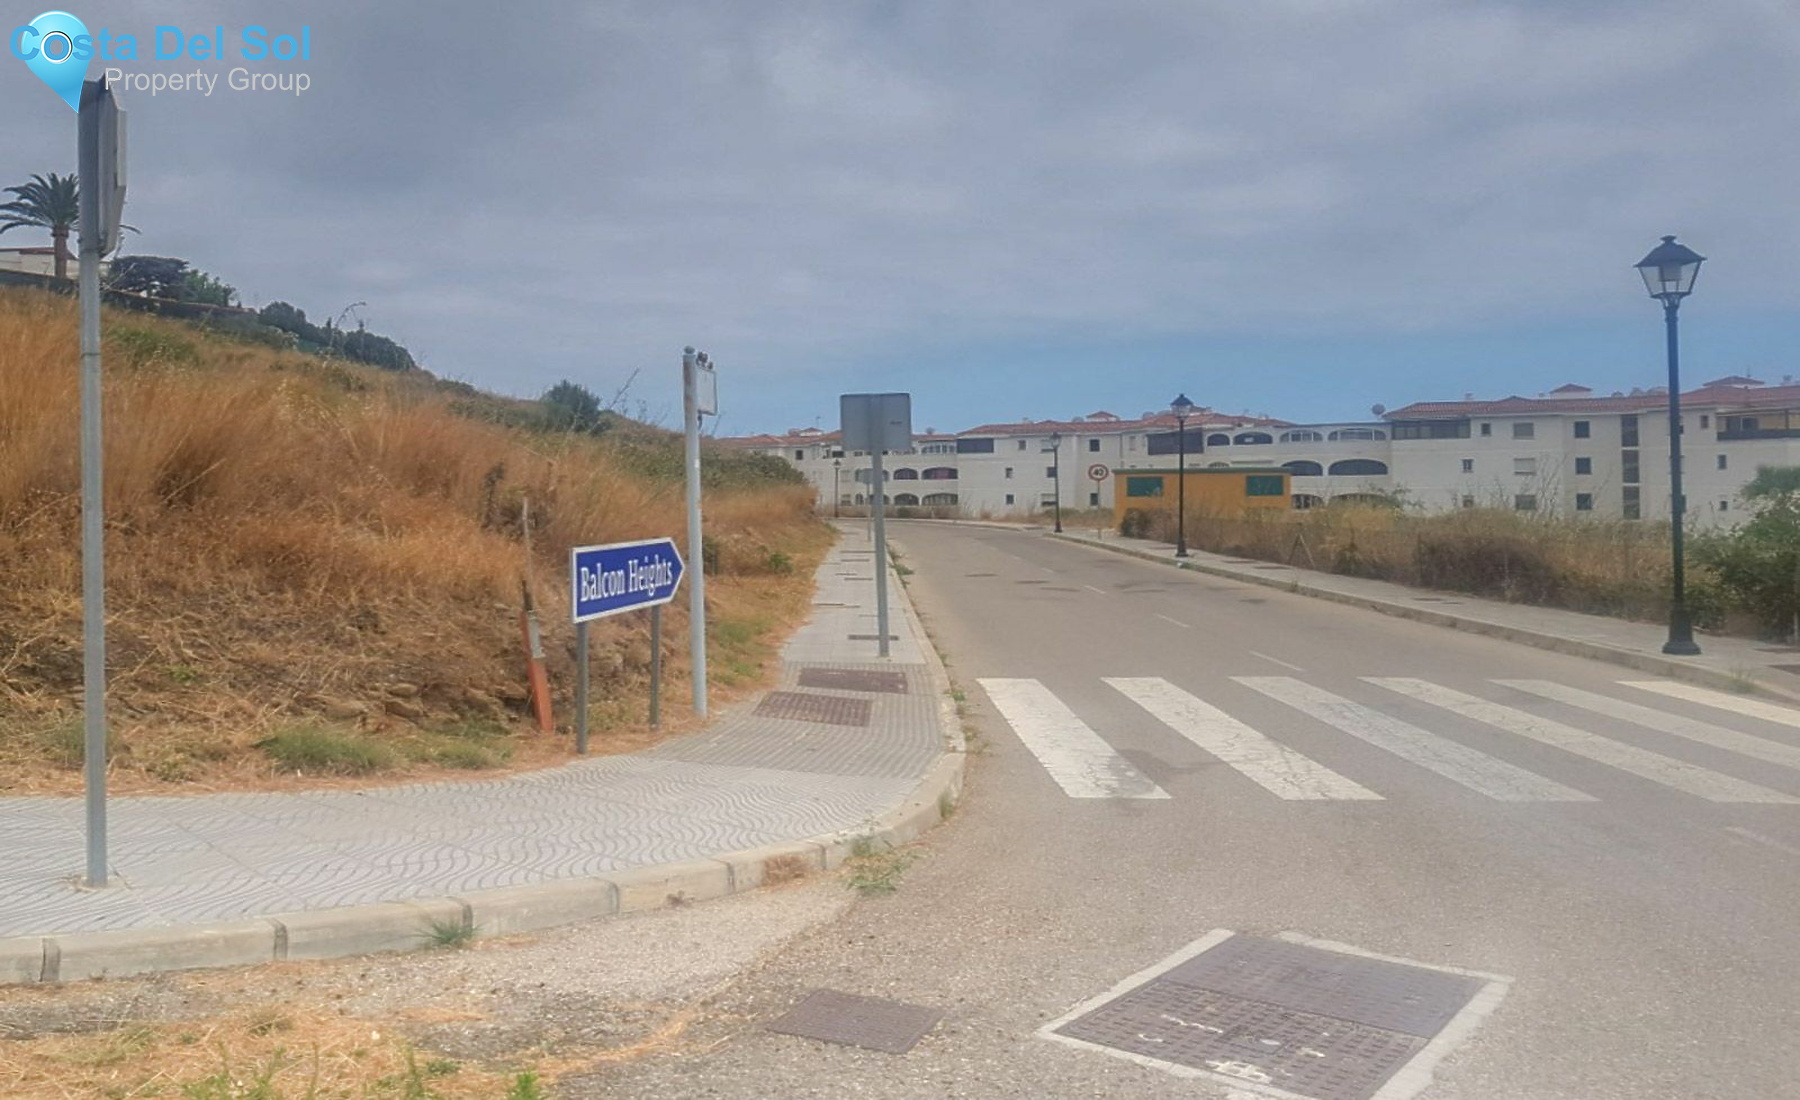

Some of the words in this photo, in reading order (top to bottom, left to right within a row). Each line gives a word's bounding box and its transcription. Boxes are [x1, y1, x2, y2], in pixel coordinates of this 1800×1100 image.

[1093, 468, 1104, 477] 40
[580, 563, 625, 602] Balcon
[628, 555, 672, 596] Heights
